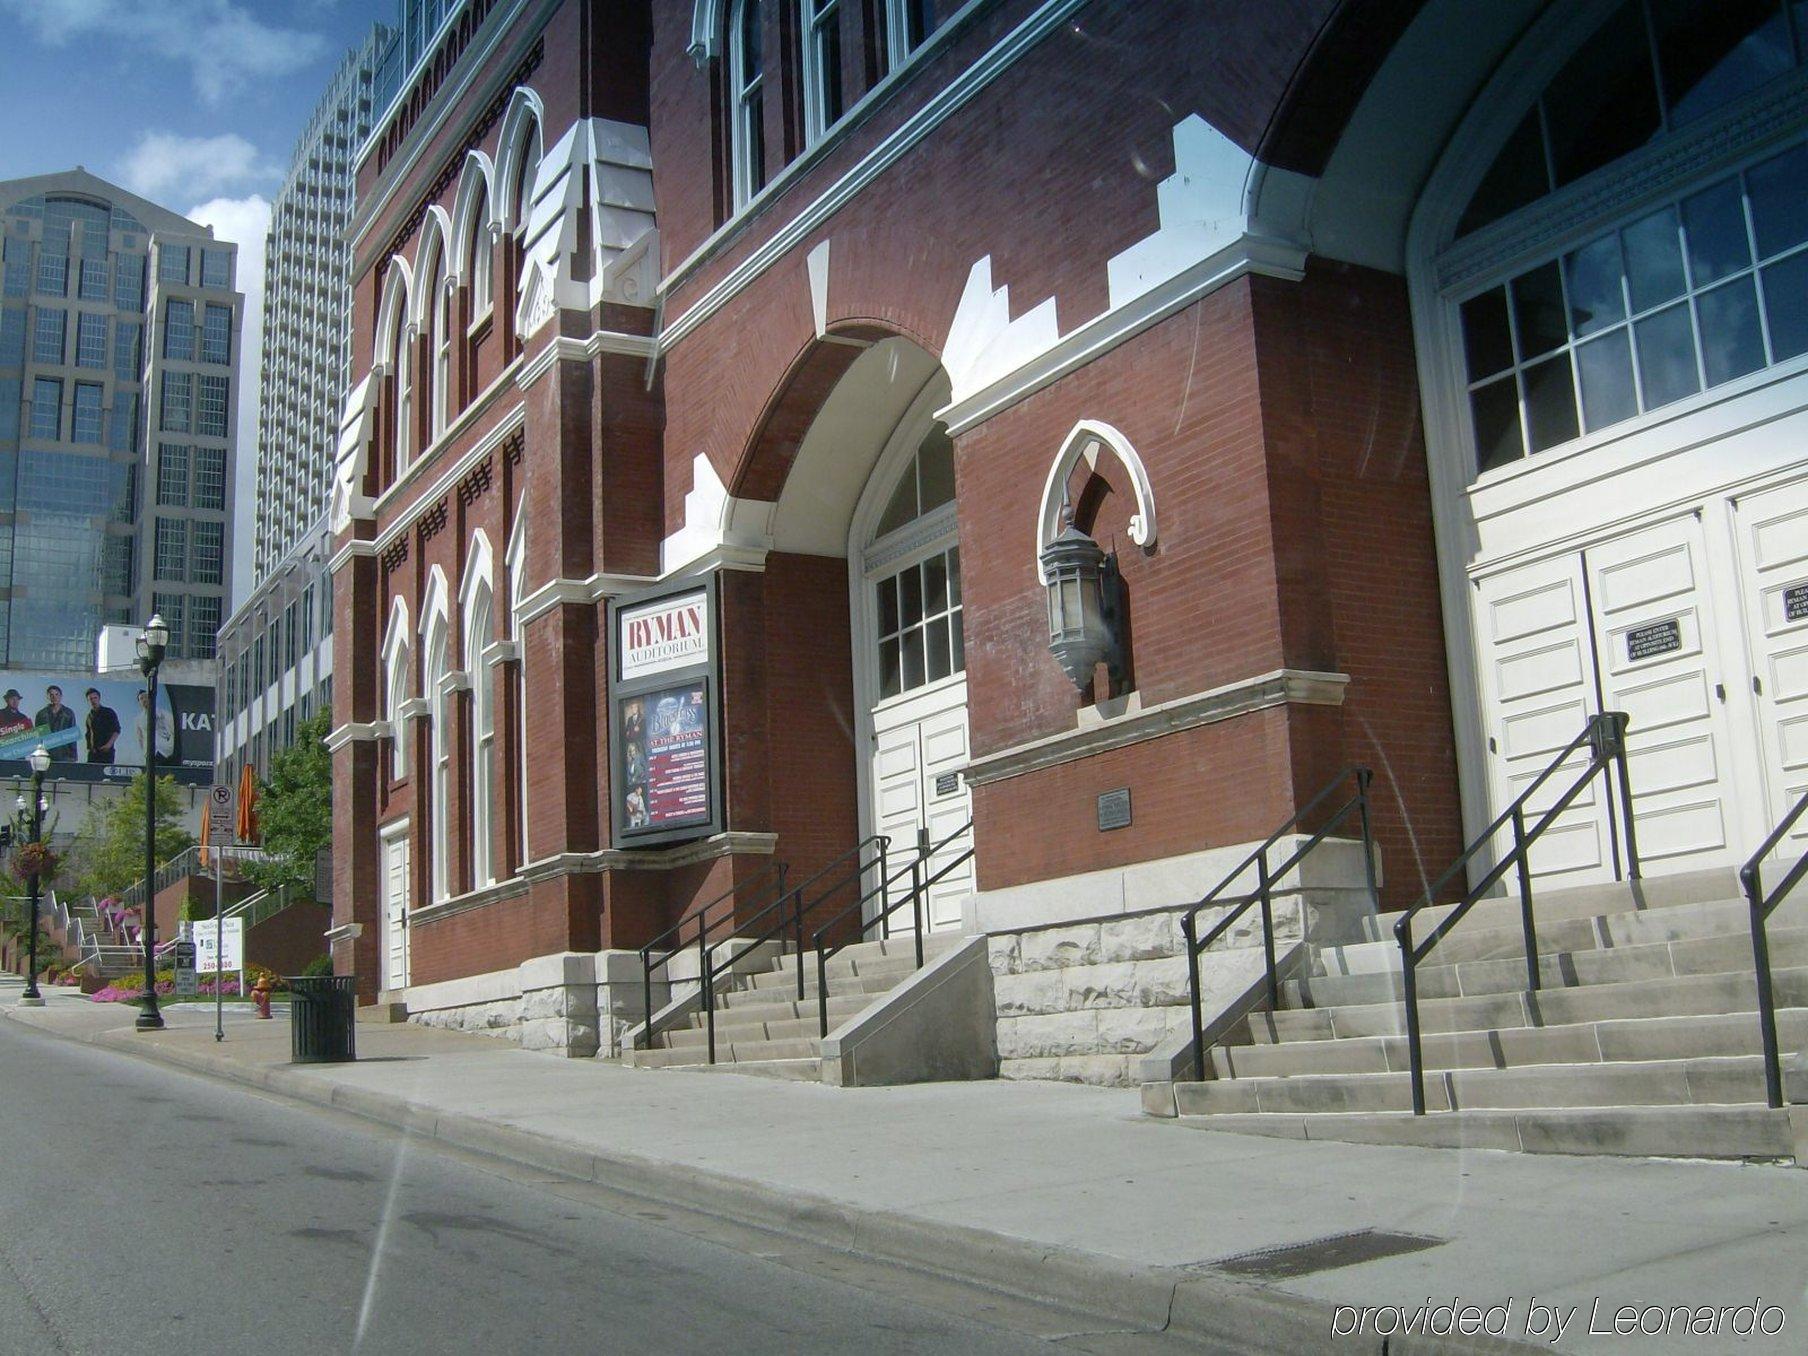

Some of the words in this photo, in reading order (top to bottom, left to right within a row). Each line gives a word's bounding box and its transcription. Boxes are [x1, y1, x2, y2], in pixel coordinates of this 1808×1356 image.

[629, 606, 701, 650] RYMAN
[630, 637, 703, 663] AUDITORIUM
[0, 722, 25, 736] Single
